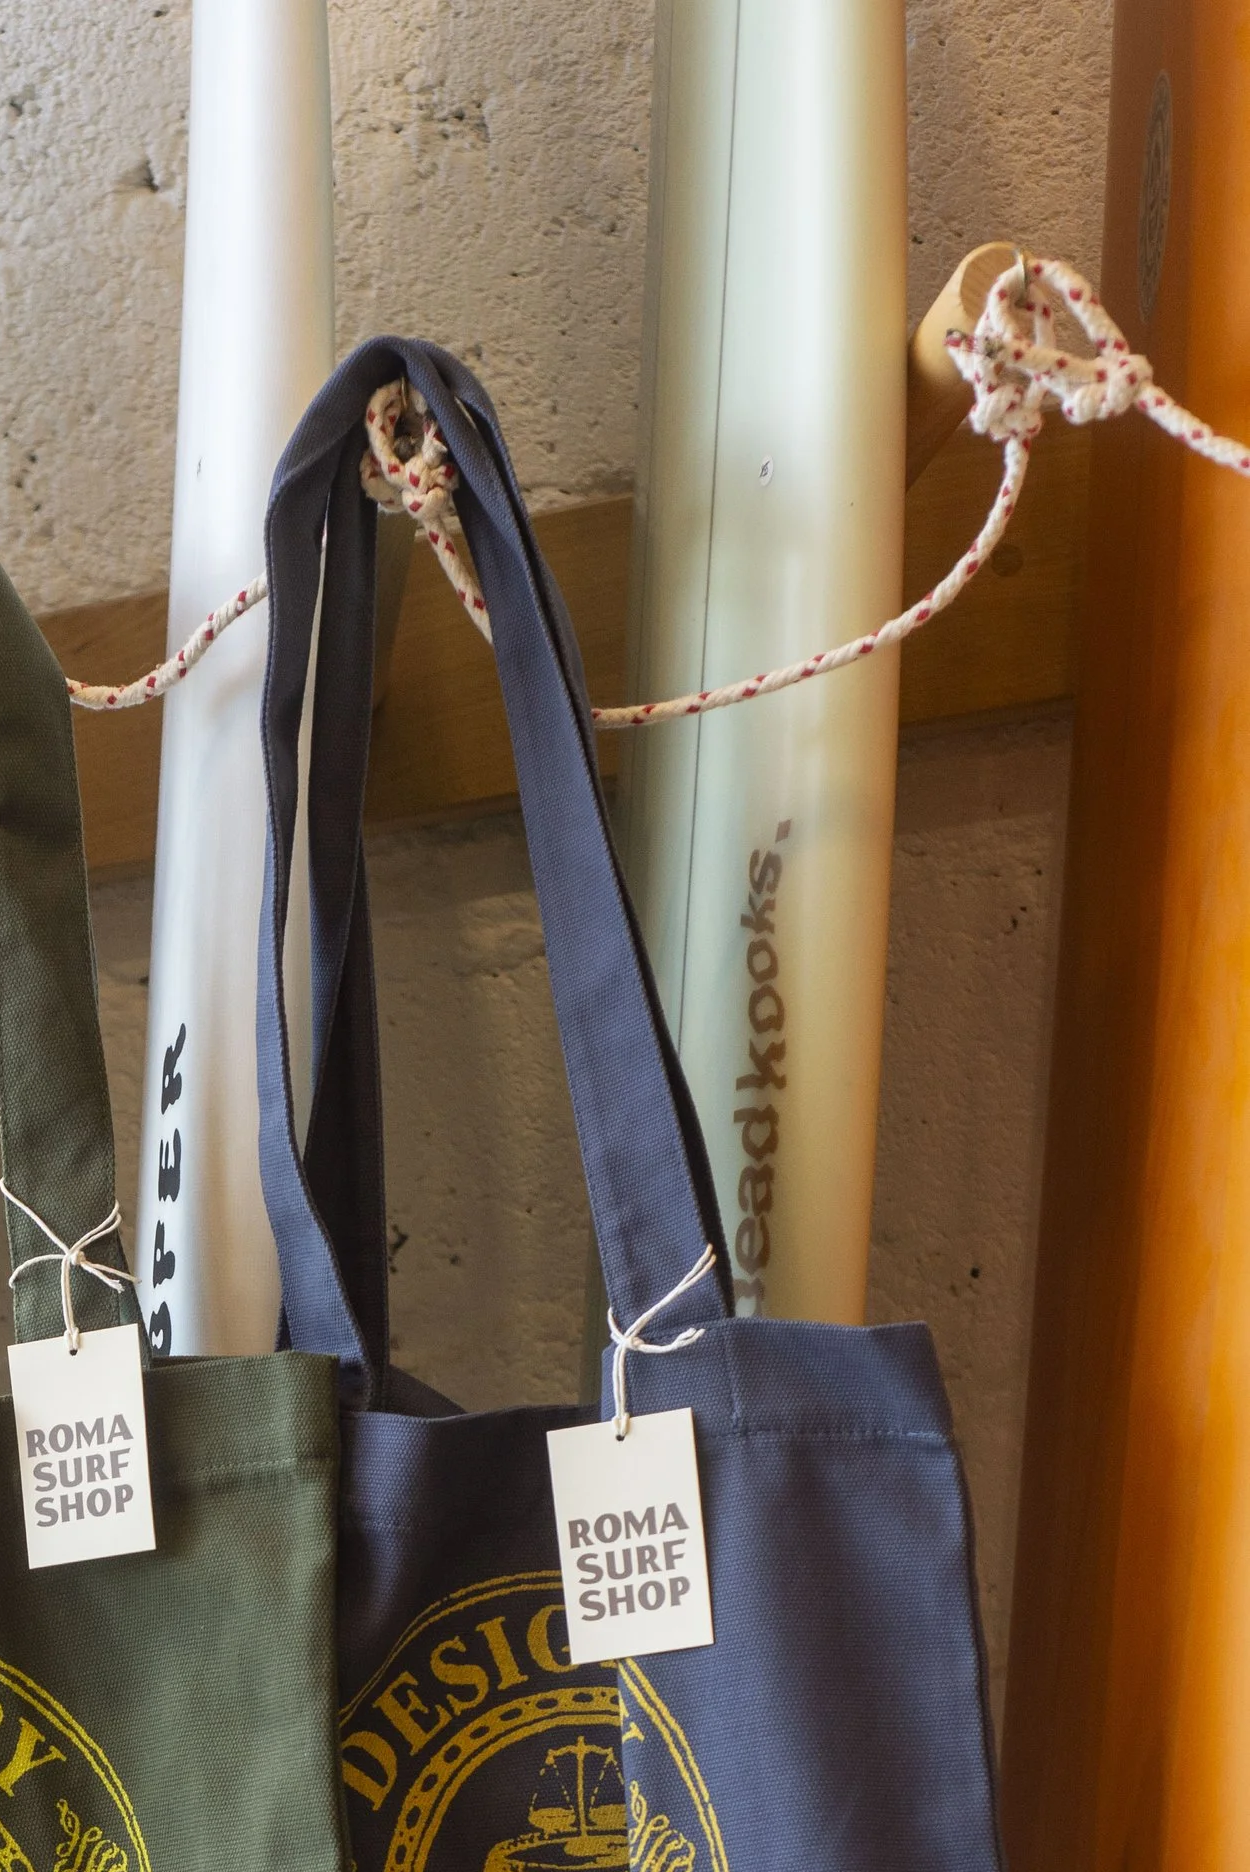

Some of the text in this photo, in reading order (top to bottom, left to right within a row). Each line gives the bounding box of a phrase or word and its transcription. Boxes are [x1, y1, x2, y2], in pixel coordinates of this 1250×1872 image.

[26, 1414, 134, 1458] ROMA
[33, 1448, 131, 1492] SURF
[34, 1484, 134, 1528] SHOP
[568, 1502, 690, 1549] ROMA
[576, 1538, 687, 1585] SURF
[579, 1576, 691, 1622] SHOP
[340, 1605, 580, 1811] DESIG
